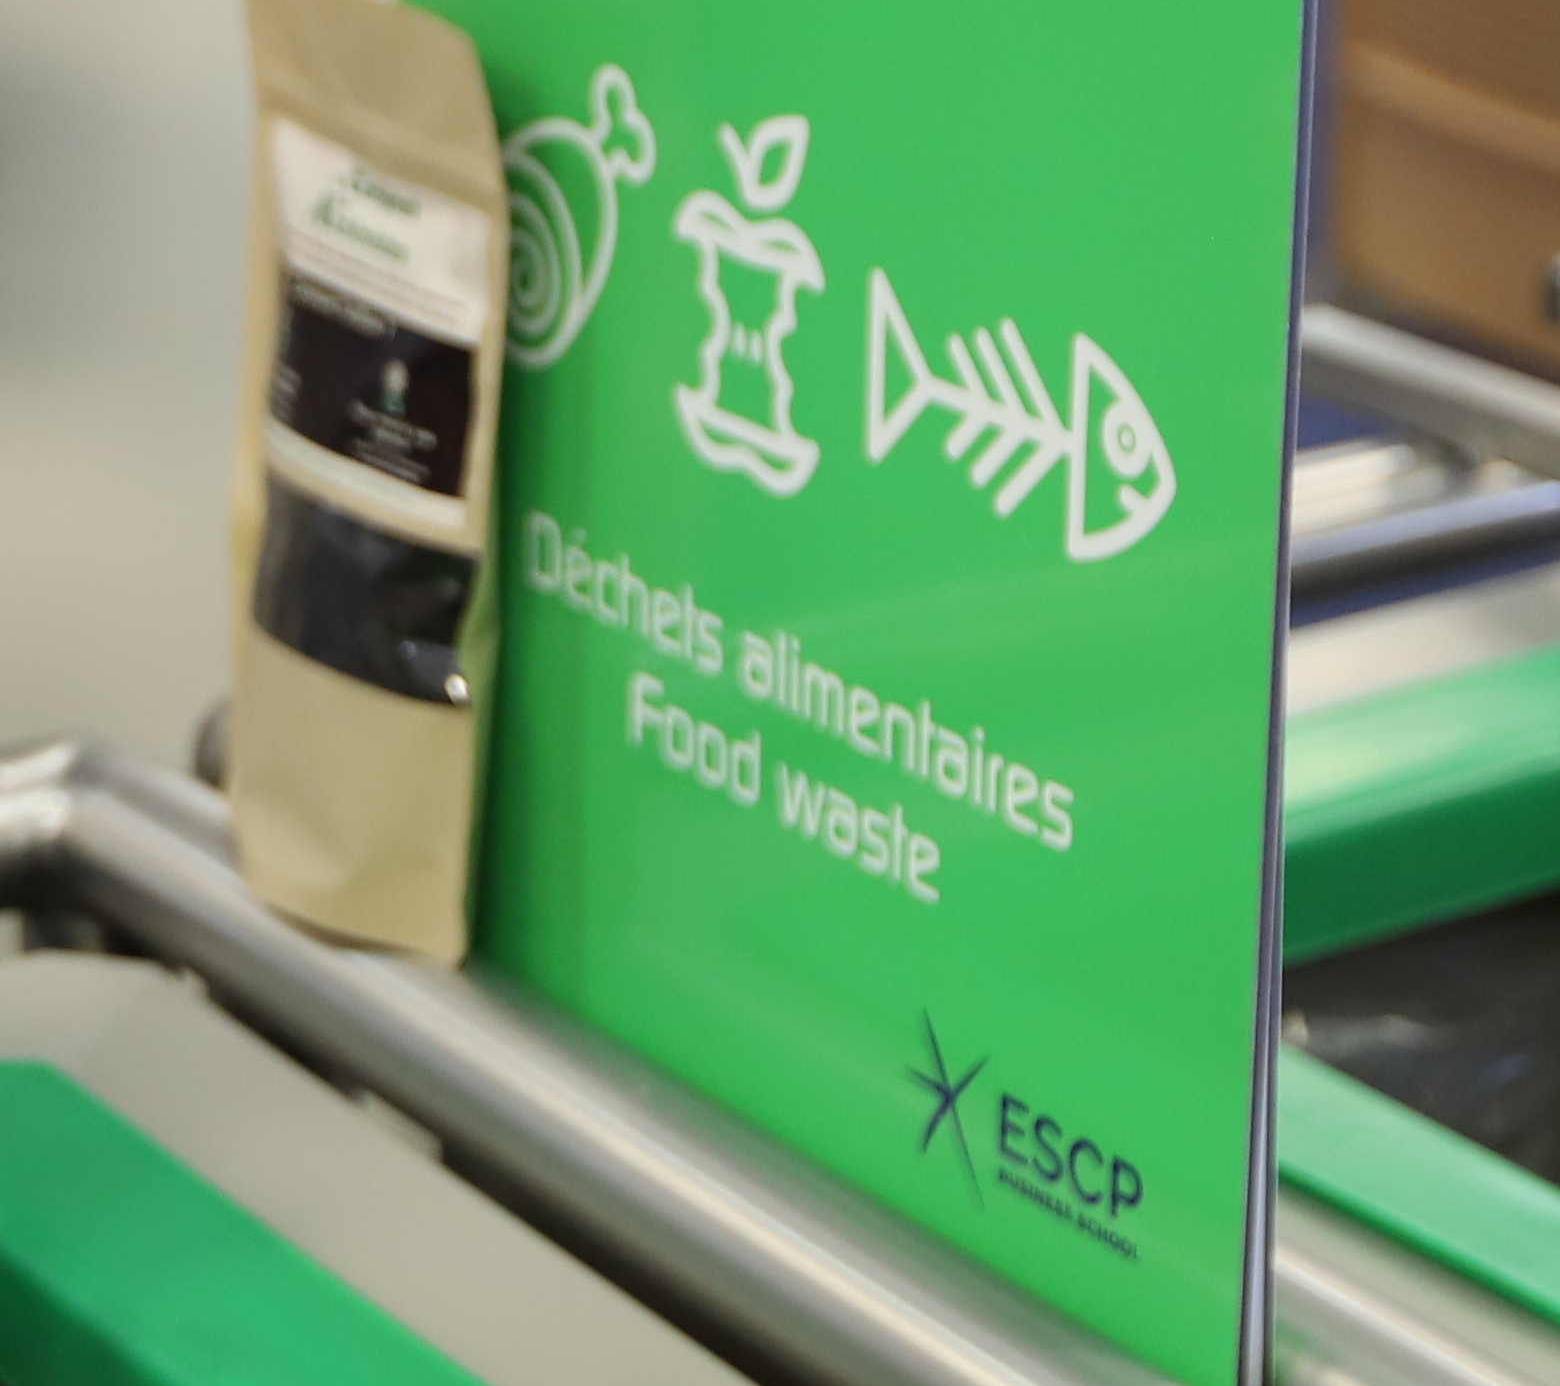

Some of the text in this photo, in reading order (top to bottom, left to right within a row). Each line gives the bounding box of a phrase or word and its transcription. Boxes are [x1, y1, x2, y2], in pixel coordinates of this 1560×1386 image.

[525, 509, 1074, 851] Déchets alimentaires
[627, 671, 941, 904] Food waste
[999, 1092, 1143, 1217] ESCP
[1078, 1213, 1139, 1260] SCHOOL
